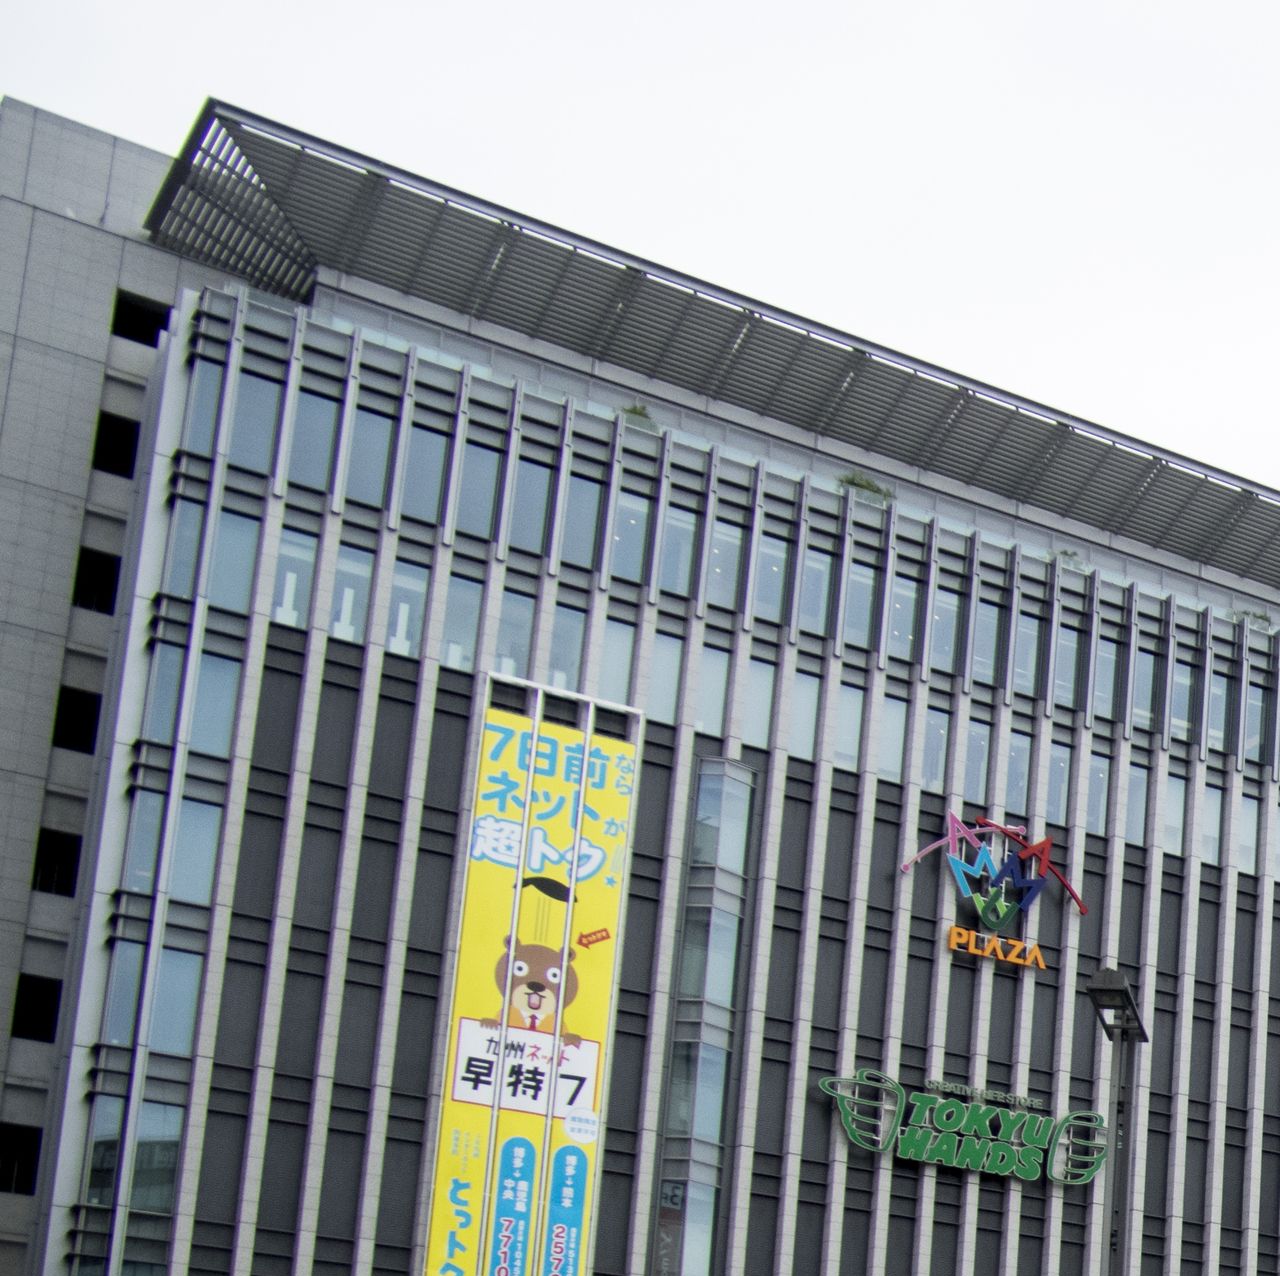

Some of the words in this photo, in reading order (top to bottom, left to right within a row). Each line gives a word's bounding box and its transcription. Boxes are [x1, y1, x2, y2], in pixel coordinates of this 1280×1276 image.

[949, 926, 1047, 969] PLAZA
[461, 1056, 587, 1106] 早特7
[925, 1079, 980, 1097] CREATIVE
[1005, 1093, 1044, 1108] STORE
[909, 1091, 1055, 1149] TOKYU
[898, 1125, 1044, 1181] HANDS
